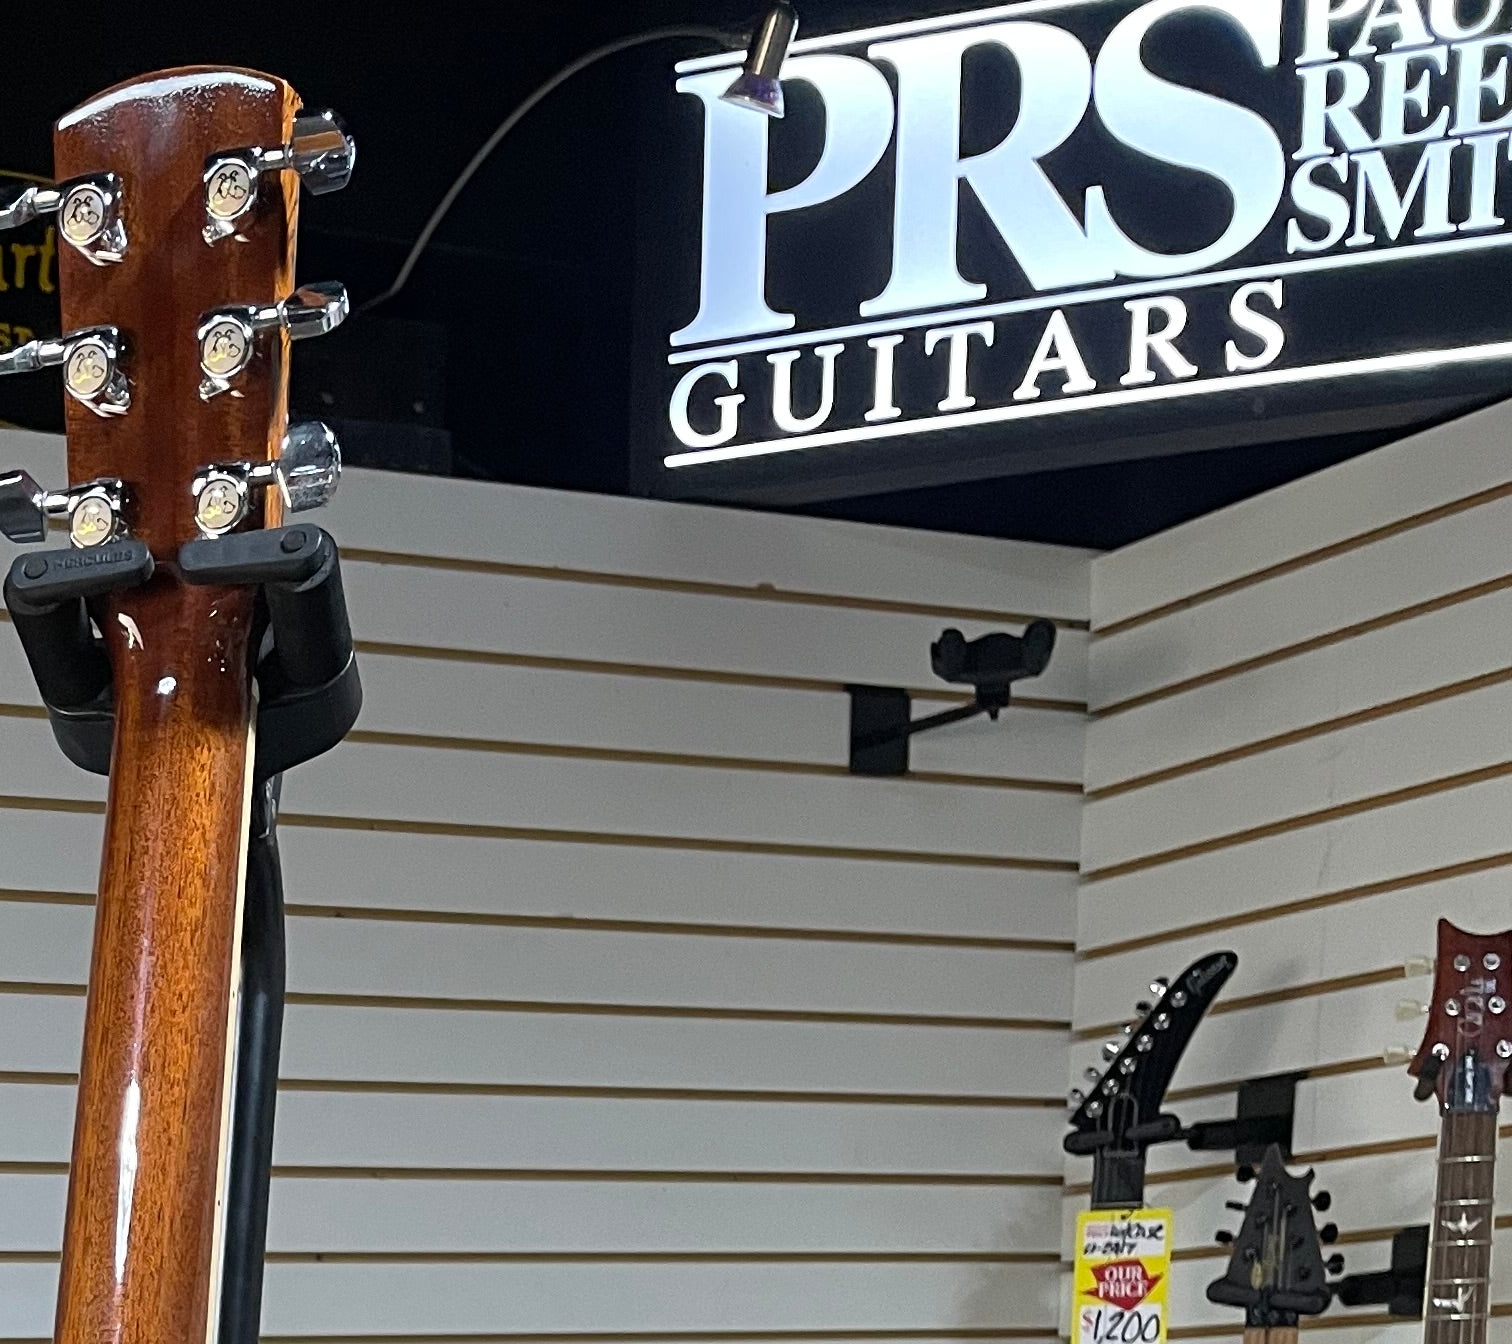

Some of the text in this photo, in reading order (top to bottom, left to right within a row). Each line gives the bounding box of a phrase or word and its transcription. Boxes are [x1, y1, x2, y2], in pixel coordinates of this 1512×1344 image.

[1294, 0, 1512, 64] PAU
[1291, 33, 1512, 160] REE
[669, 0, 1288, 347] PRS
[1287, 130, 1512, 254] SMI
[669, 279, 1285, 448] GUITARS
[1098, 1280, 1149, 1299] PRICE
[1104, 1265, 1143, 1282] OUR
[1082, 1309, 1161, 1344] $1,200
